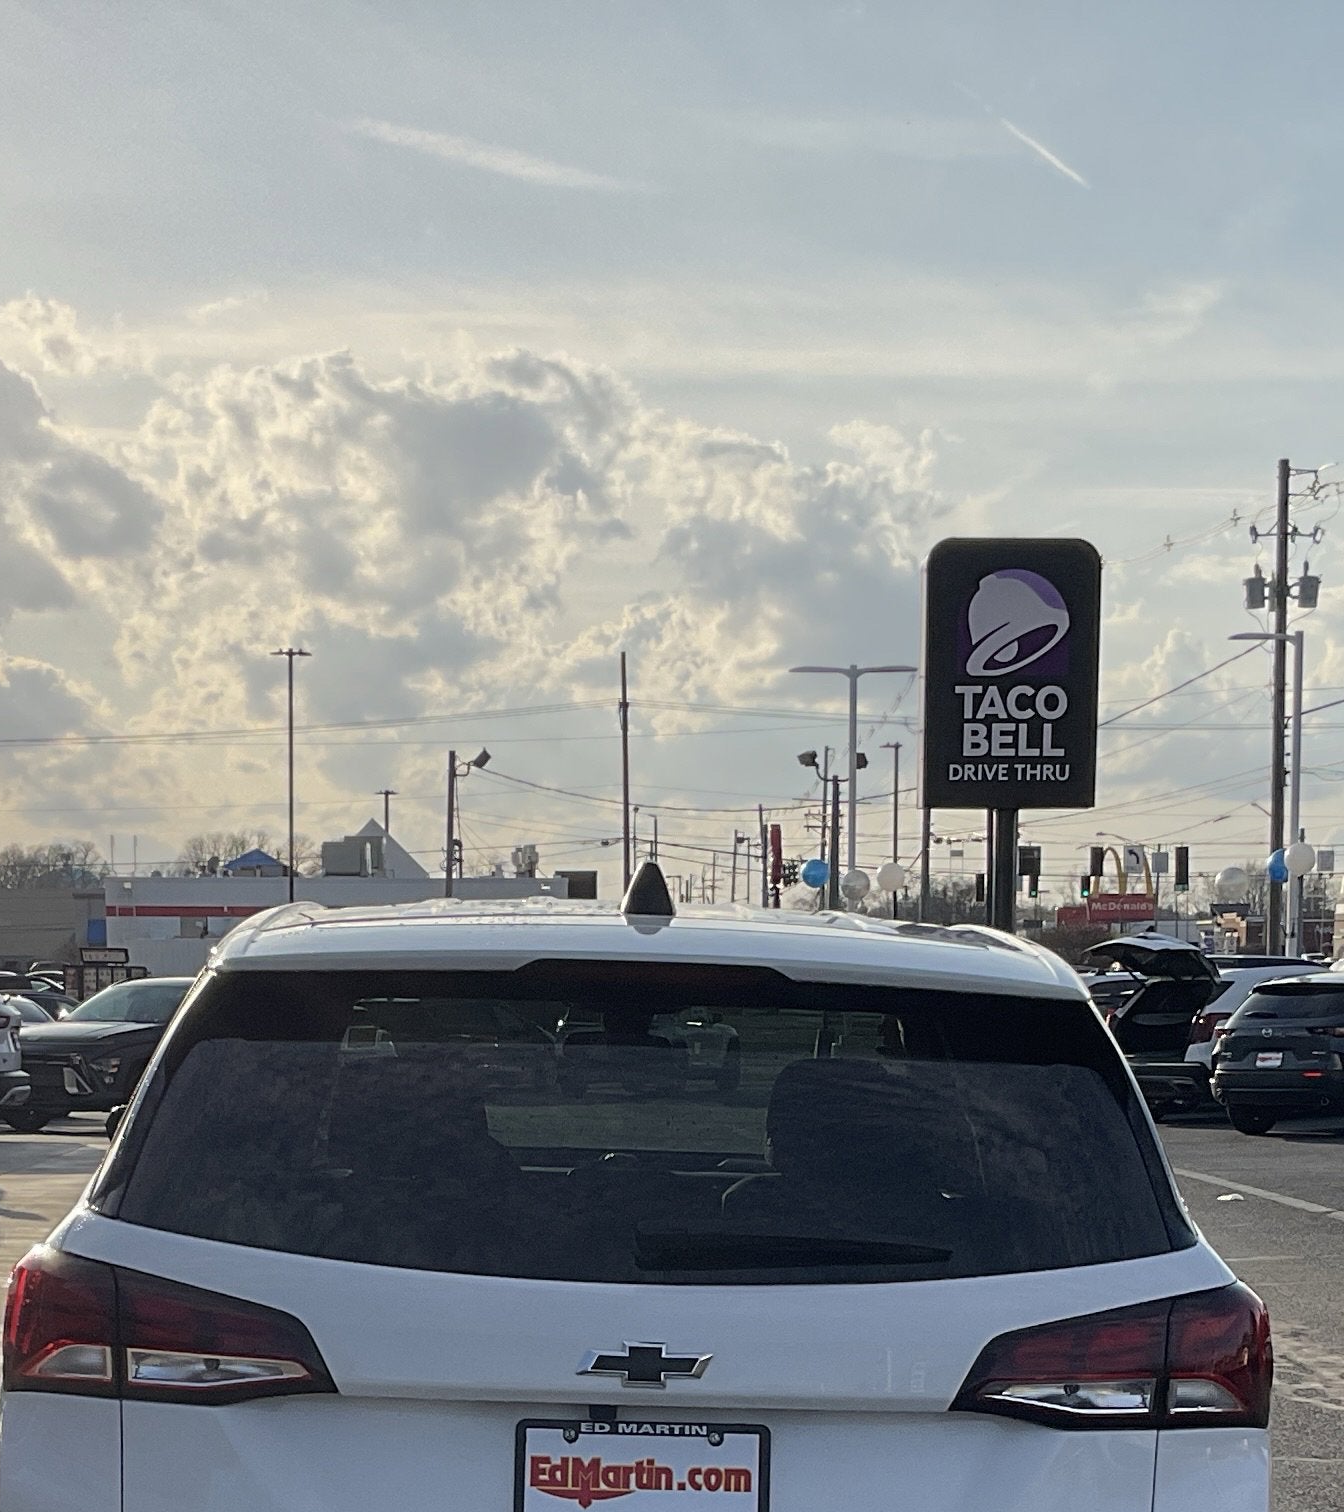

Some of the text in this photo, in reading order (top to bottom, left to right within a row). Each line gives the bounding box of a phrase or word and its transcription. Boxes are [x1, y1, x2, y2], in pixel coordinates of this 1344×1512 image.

[954, 685, 1068, 720] TACO
[962, 722, 1065, 757] BELL
[948, 763, 1070, 781] DRIVE THRU
[580, 1422, 708, 1435] ED MARTIN
